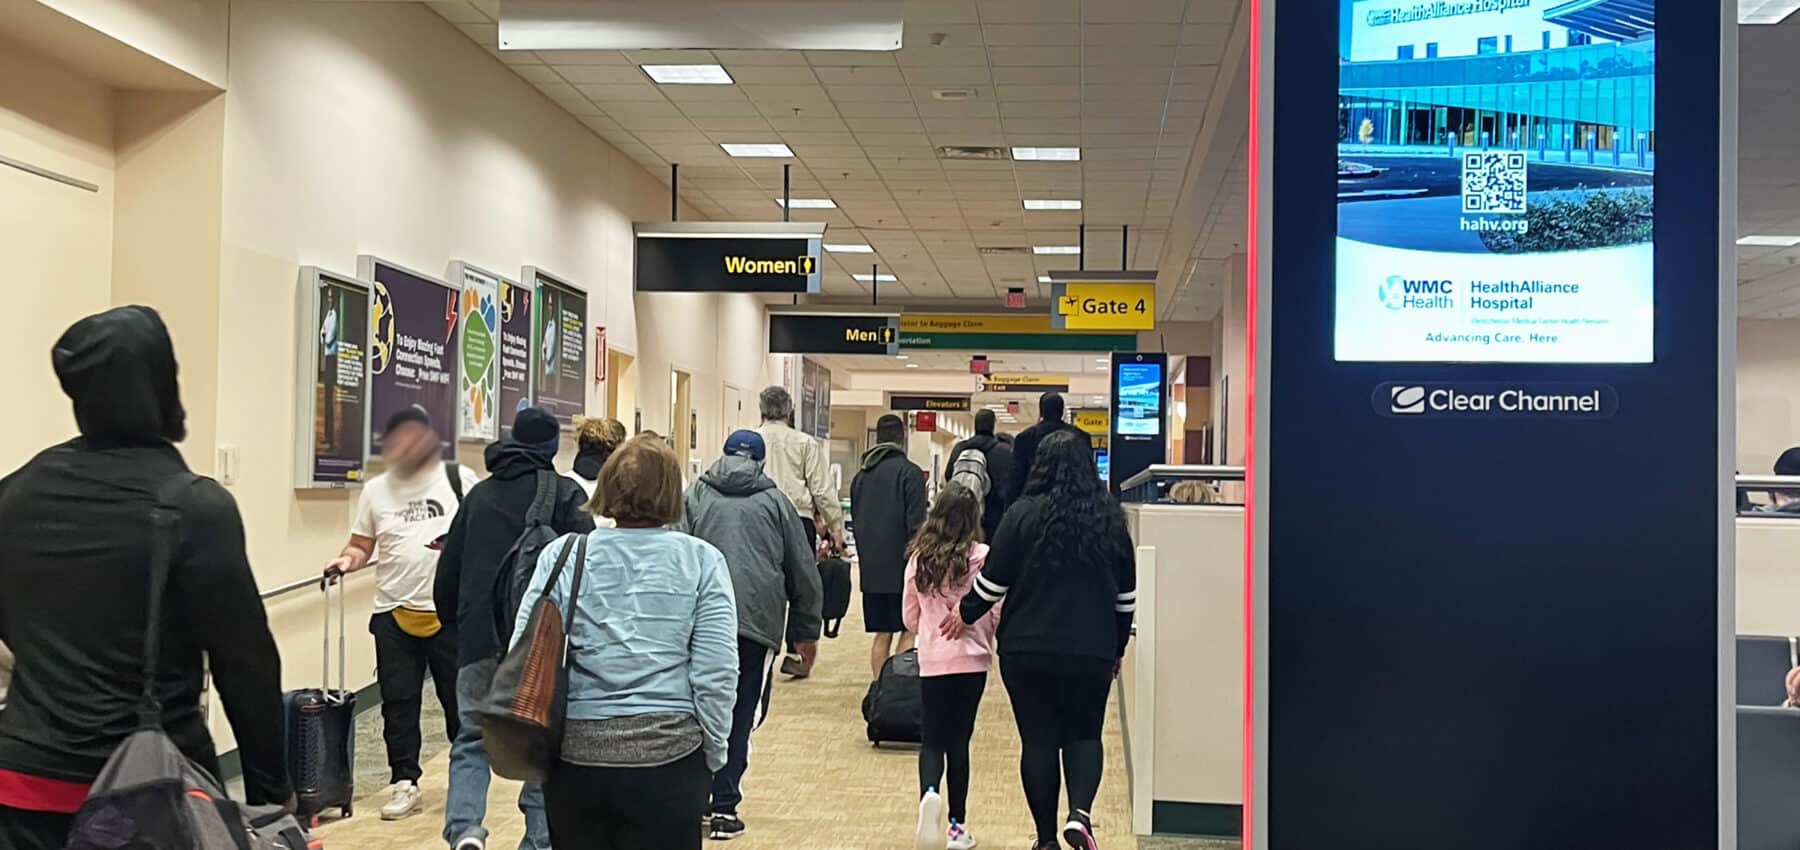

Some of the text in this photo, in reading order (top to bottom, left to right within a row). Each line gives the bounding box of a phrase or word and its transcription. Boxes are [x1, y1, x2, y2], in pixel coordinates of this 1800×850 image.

[1460, 217, 1528, 233] hahv.org
[725, 256, 796, 274] Women
[1403, 280, 1453, 294] WMC
[1471, 280, 1579, 294] HealthAlliance
[1082, 298, 1146, 314] Gate 4
[1403, 296, 1454, 309] Health
[1471, 296, 1533, 312] Hospital
[930, 319, 961, 329] Baggage
[963, 320, 984, 329] Claim
[845, 329, 876, 342] Men
[1426, 332, 1490, 345] Advancing
[926, 400, 960, 409] Elevators
[1430, 389, 1599, 412] Clear Channel
[1083, 418, 1104, 426] Gate
